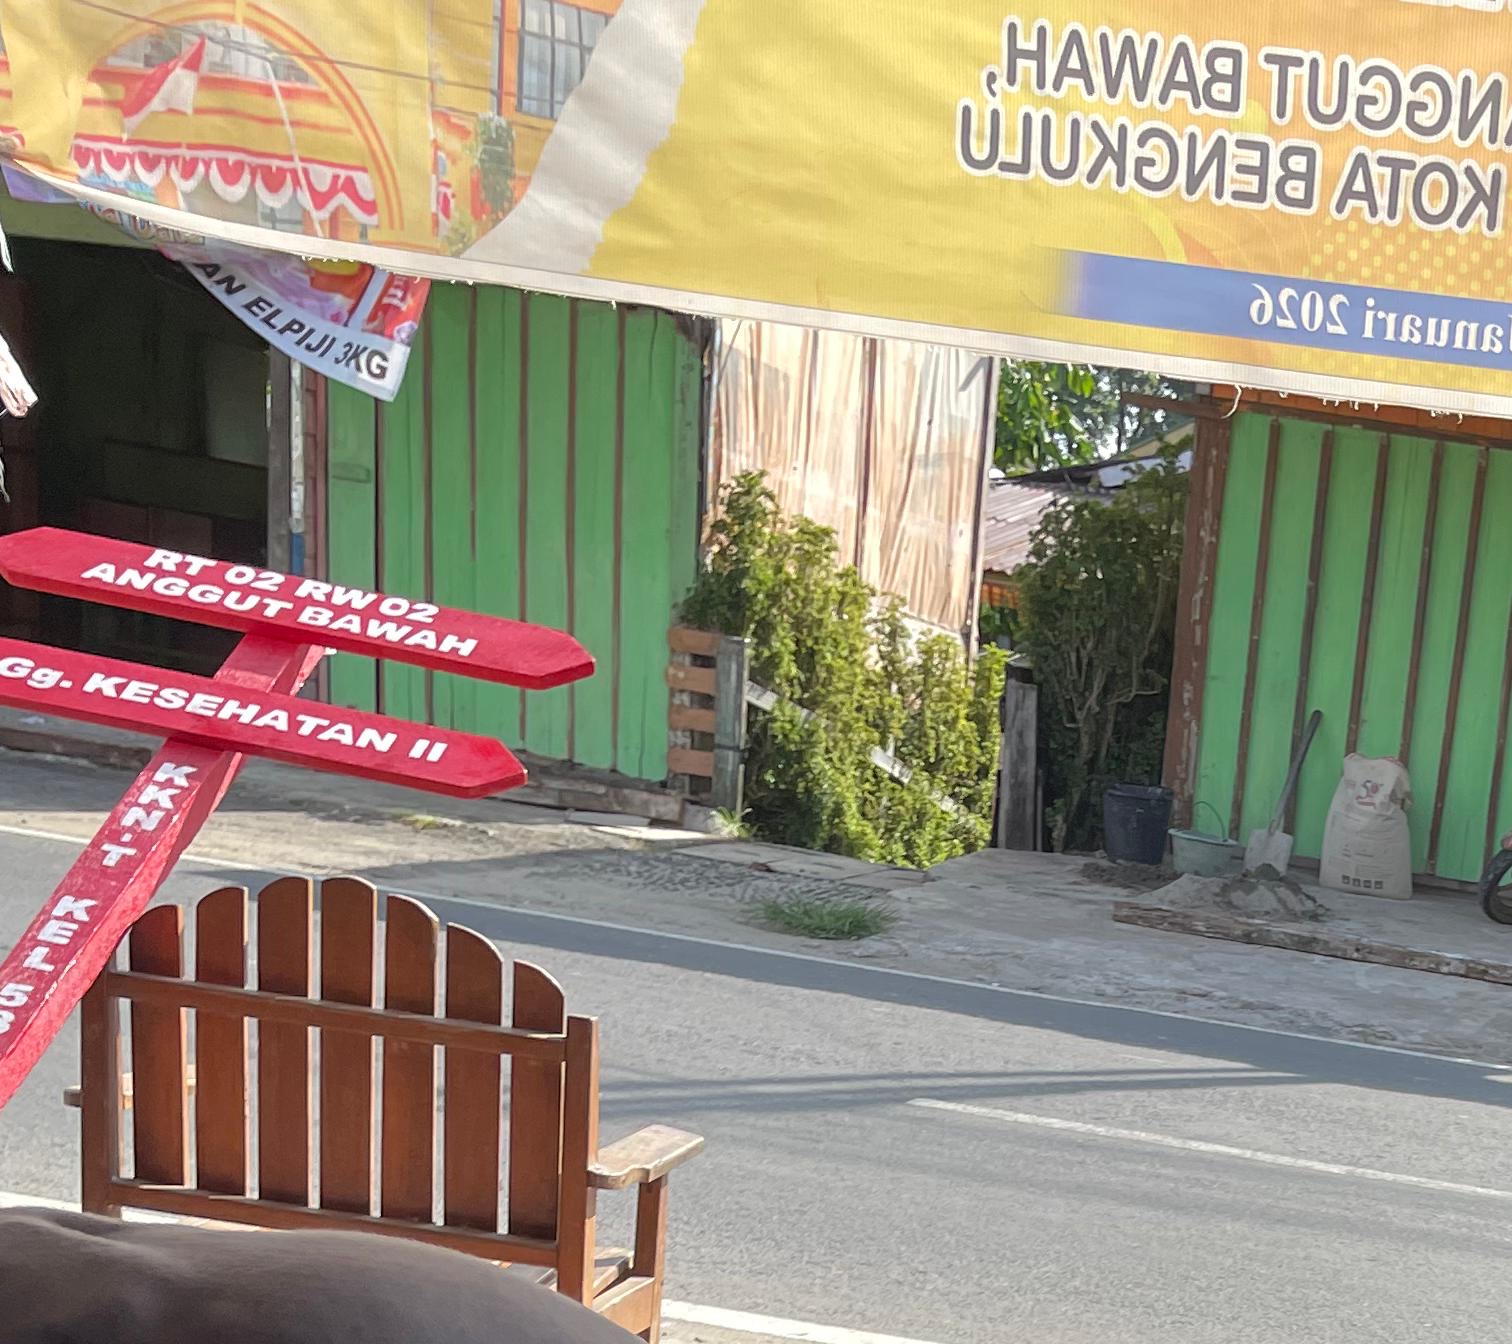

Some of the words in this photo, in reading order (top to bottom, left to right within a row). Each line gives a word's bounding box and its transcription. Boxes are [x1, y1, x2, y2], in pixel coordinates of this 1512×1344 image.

[241, 295, 337, 360] ELPIJI
[333, 340, 390, 381] 3KG
[81, 561, 297, 618] ANGGUT
[298, 603, 478, 658] BAWAH
[142, 548, 220, 577] RT
[221, 565, 286, 595] 02
[295, 578, 378, 611] RW
[375, 596, 439, 624] 02
[0, 657, 72, 689] Gg.
[83, 672, 397, 753] KESEHATAN
[409, 739, 448, 763] II
